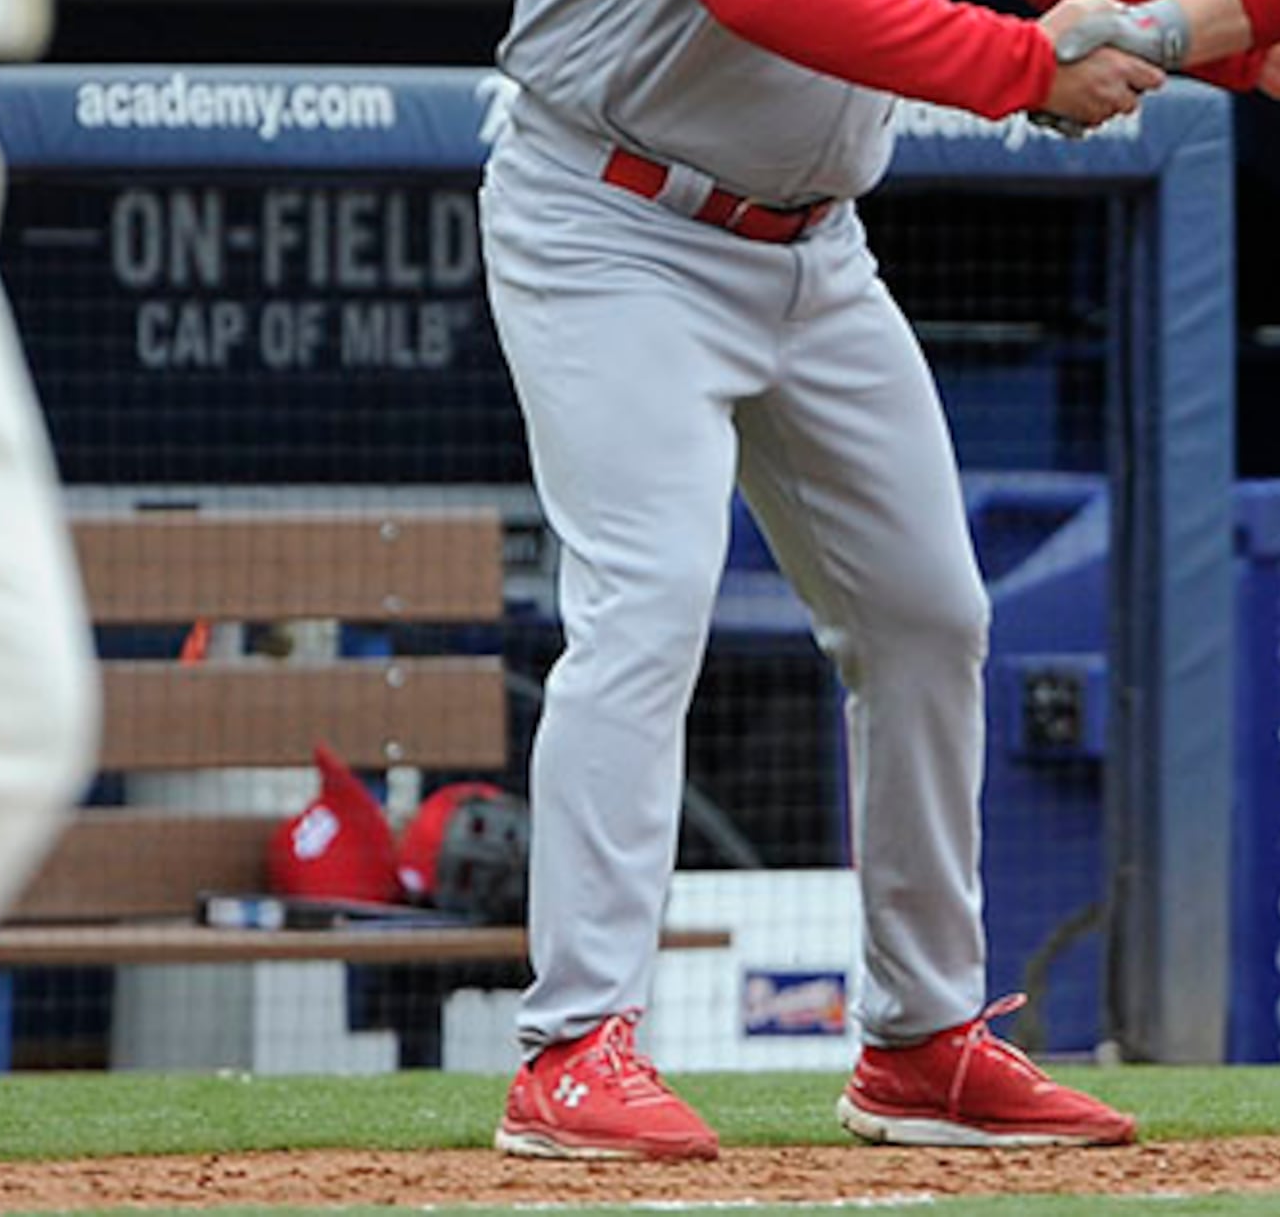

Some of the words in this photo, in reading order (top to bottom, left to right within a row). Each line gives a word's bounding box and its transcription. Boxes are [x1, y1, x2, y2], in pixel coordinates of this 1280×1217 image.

[75, 72, 397, 141] academy.com
[110, 187, 477, 286] ON-FIELD
[136, 302, 245, 368] CAP
[260, 302, 322, 368] OF
